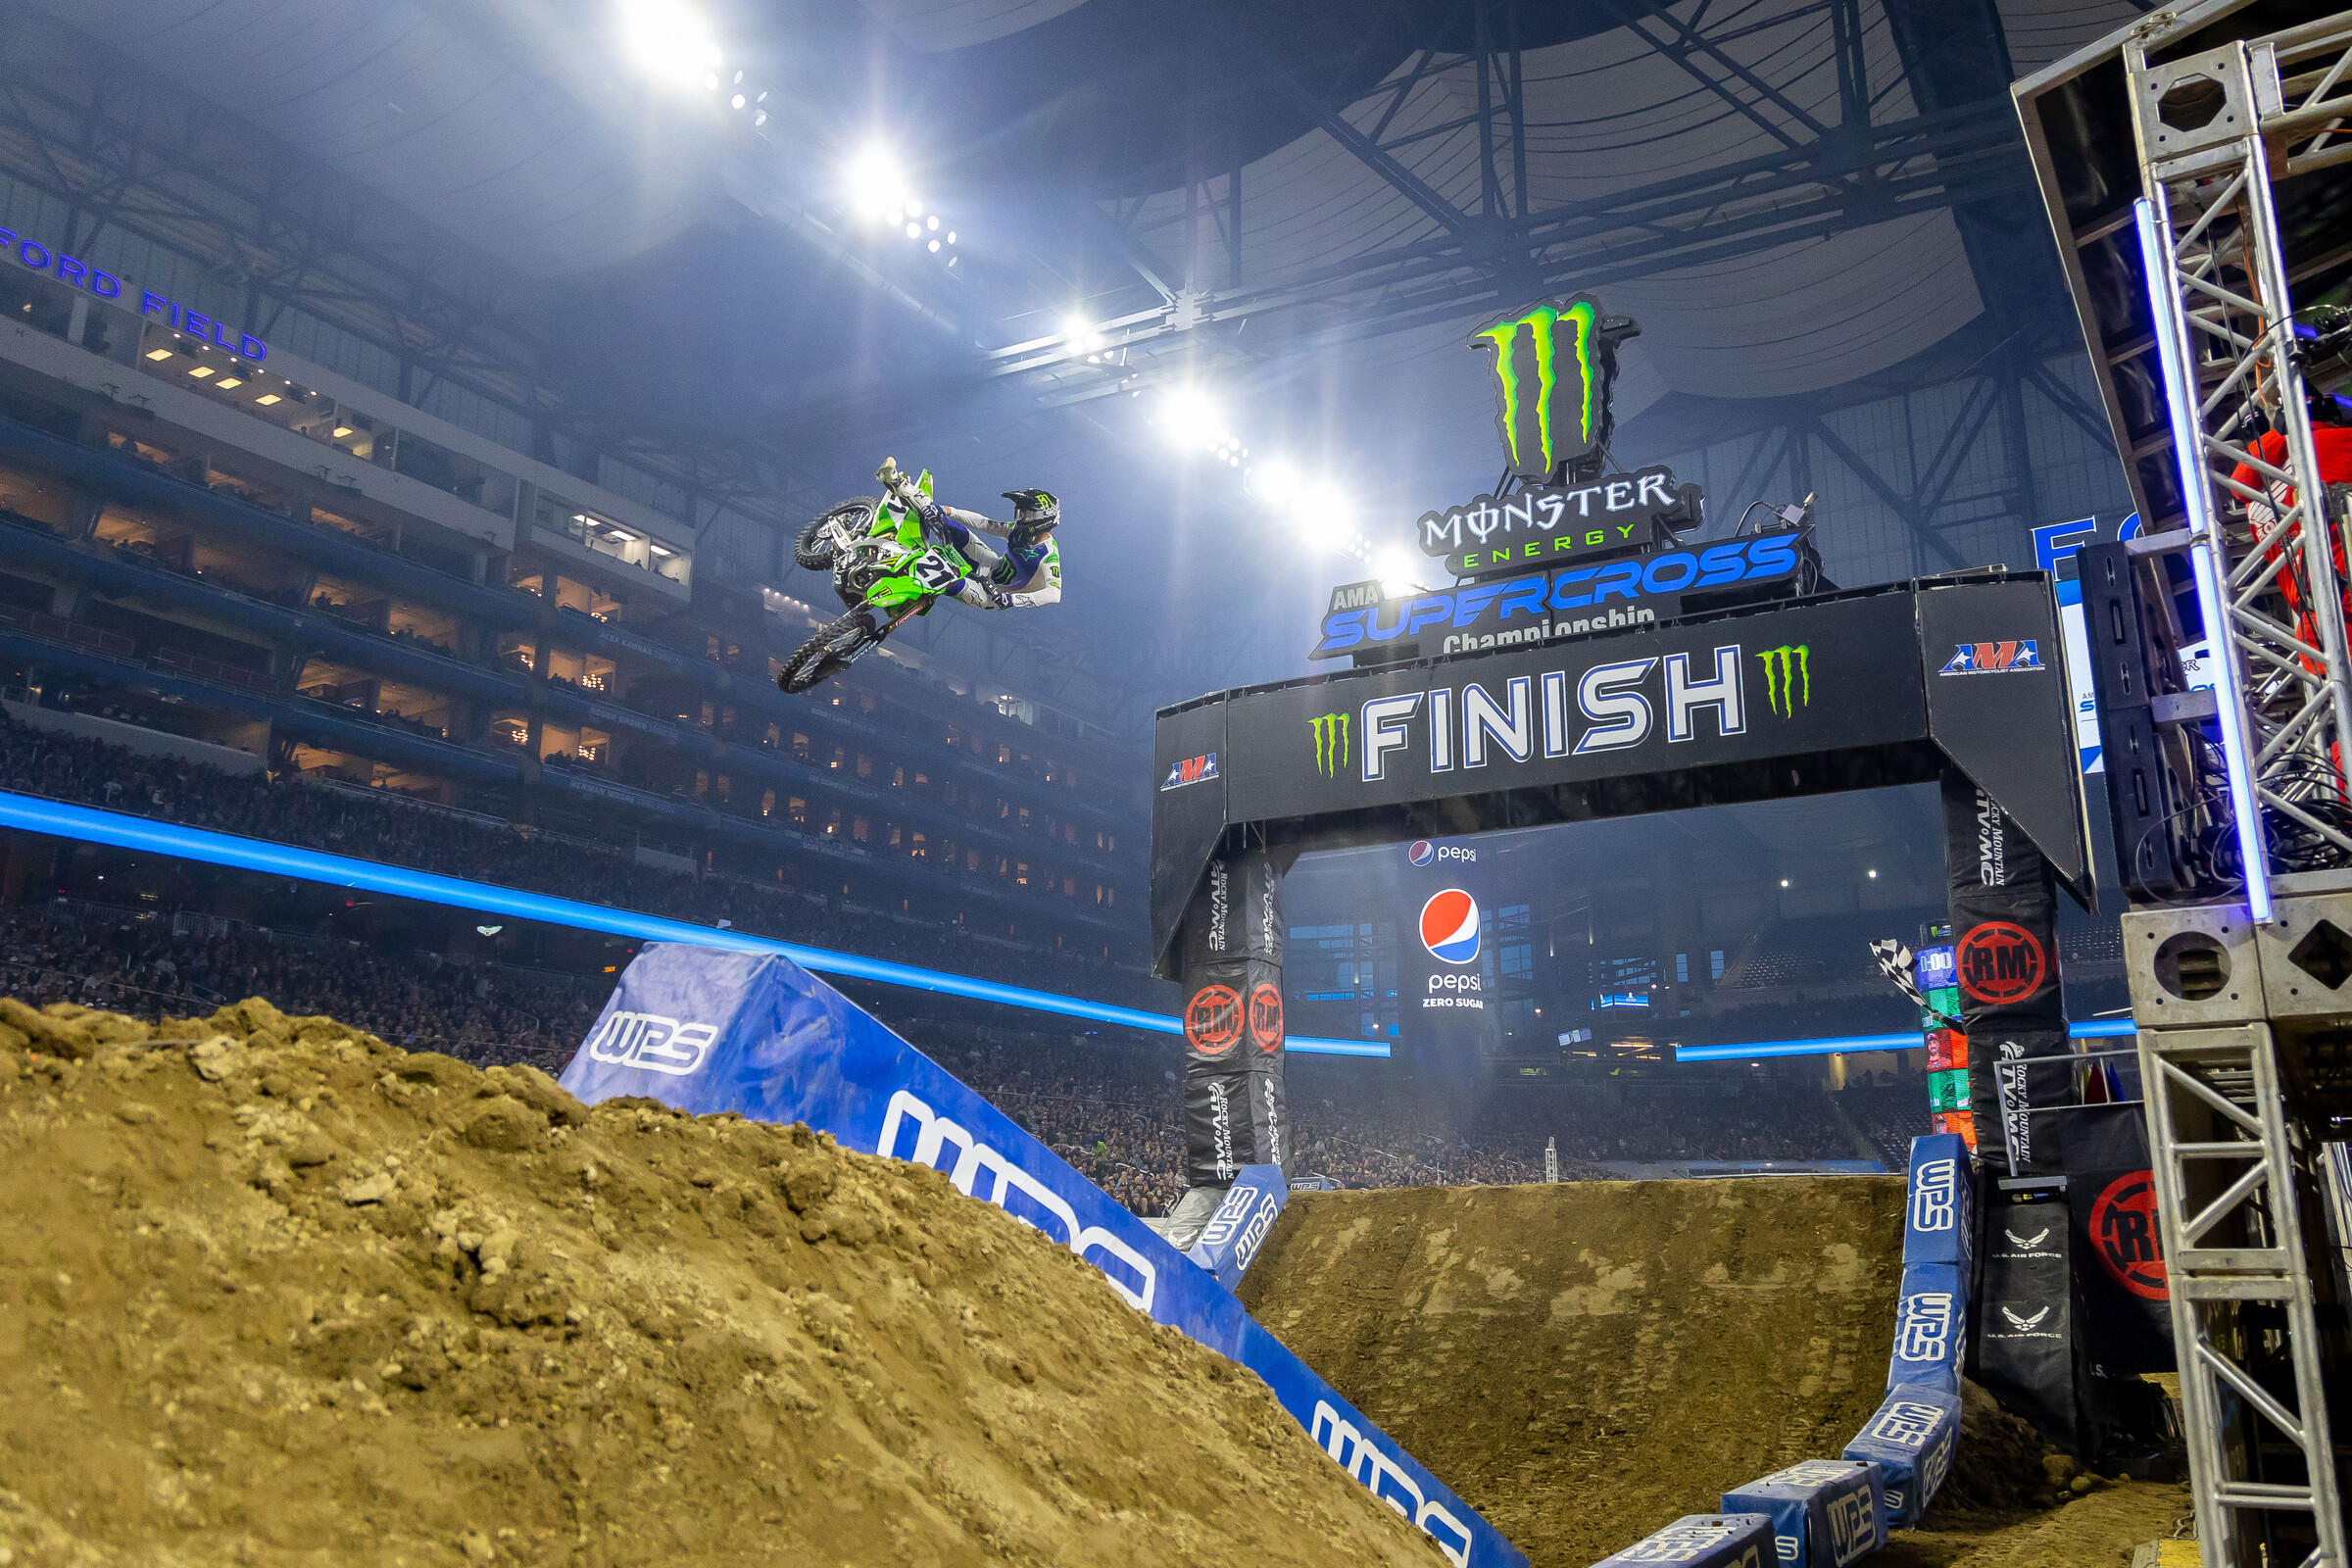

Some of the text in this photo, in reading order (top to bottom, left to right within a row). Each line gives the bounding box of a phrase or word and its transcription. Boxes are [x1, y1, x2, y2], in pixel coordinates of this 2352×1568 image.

[140, 290, 268, 363] FIELD
[916, 556, 956, 589] 21
[1463, 523, 1636, 569] ENERGY
[1319, 533, 1800, 652] SUPERCROSS
[1333, 584, 1380, 612] AMA
[1938, 639, 2045, 672] AMA
[1361, 644, 1747, 783] FINISH
[1159, 753, 1220, 788] AMA
[1438, 847, 1477, 863] pepsi
[1992, 827, 2005, 887] MOUNTAIN
[1218, 902, 1229, 951] MOUNTAIN
[1428, 973, 1482, 994] pepsi
[1971, 945, 2029, 981] RM
[1422, 998, 1484, 1009] ZERO SUGAR
[589, 1010, 719, 1076] WPS
[1220, 1097, 1235, 1180] ROCKY MOUNTAIN
[2019, 1099, 2031, 1163] MOUNTAIN
[1290, 1181, 1321, 1192] WPS
[1912, 1158, 1955, 1233] WPS
[1198, 1186, 1259, 1246] WPS
[1234, 1193, 1279, 1271] WPS
[1899, 1292, 1953, 1361] WPS
[1871, 1400, 1945, 1447] WPS
[1826, 1484, 1877, 1568] WPS
